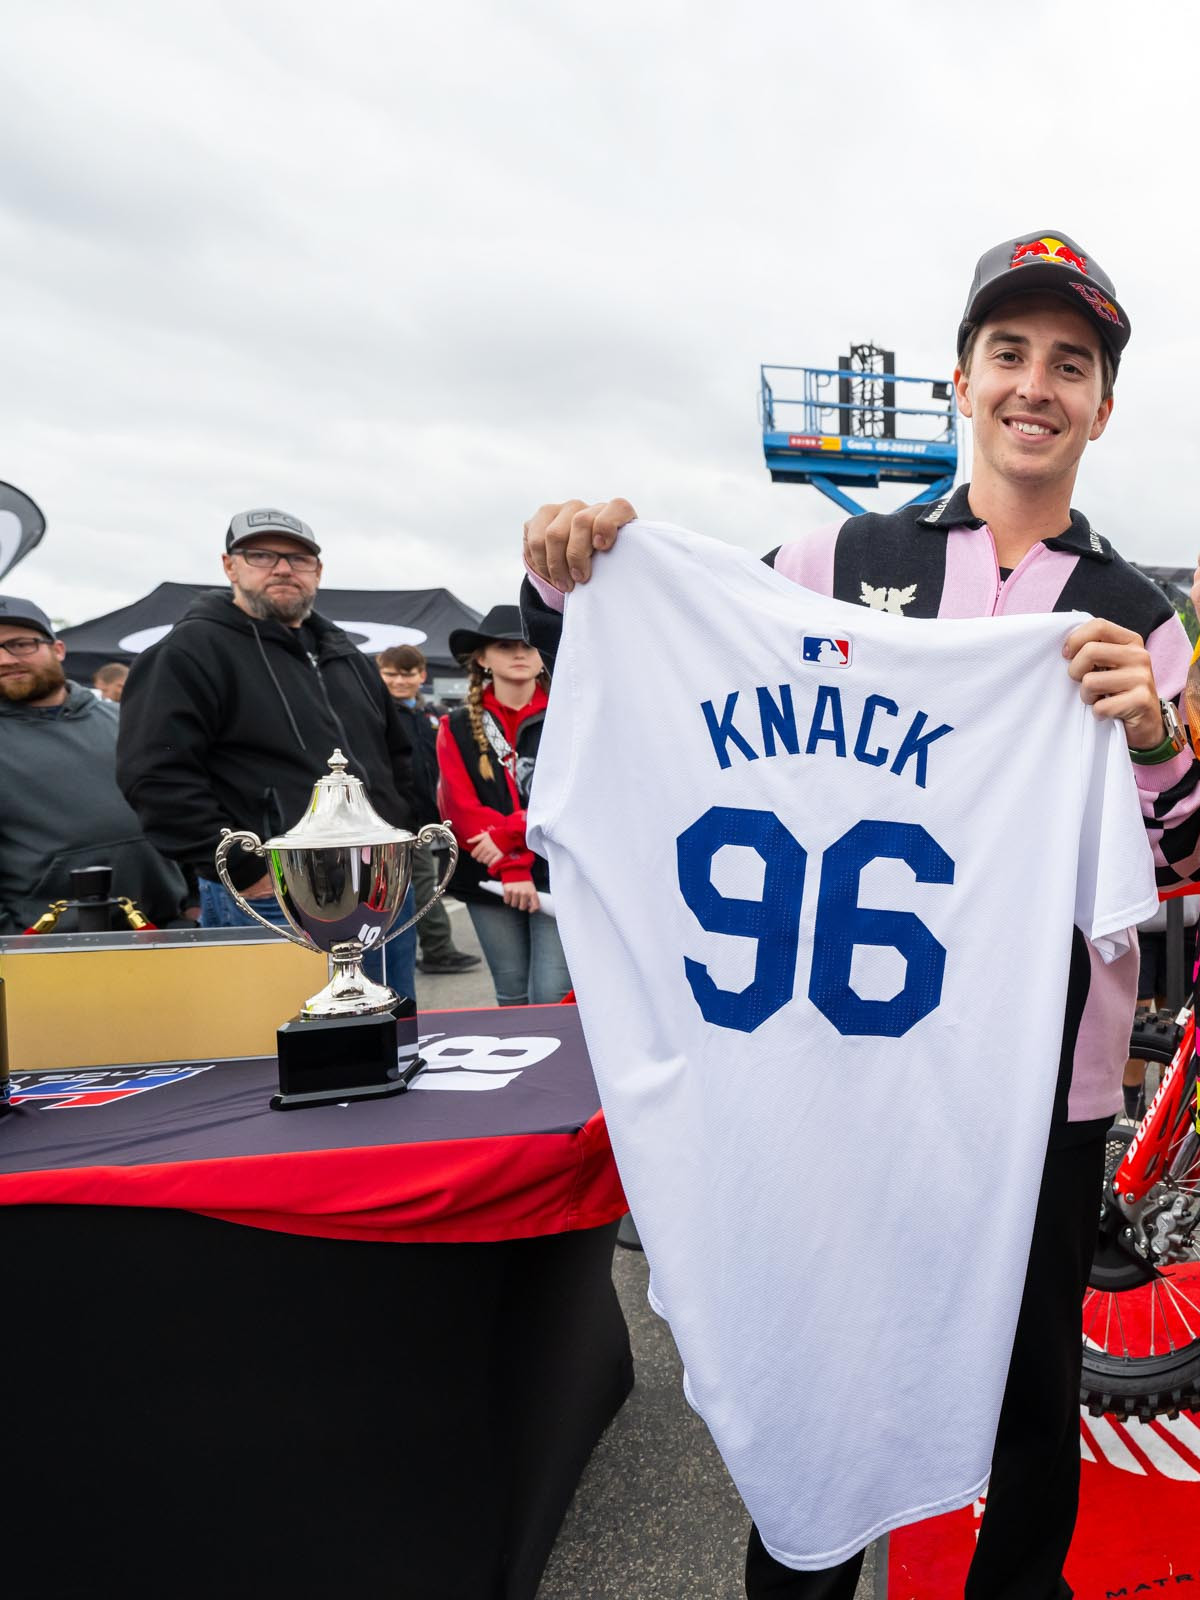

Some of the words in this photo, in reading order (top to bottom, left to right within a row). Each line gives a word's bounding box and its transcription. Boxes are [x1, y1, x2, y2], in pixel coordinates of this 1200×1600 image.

[700, 684, 955, 790] KNACK
[676, 806, 956, 1038] 96
[1127, 1048, 1182, 1164] DUNLOP
